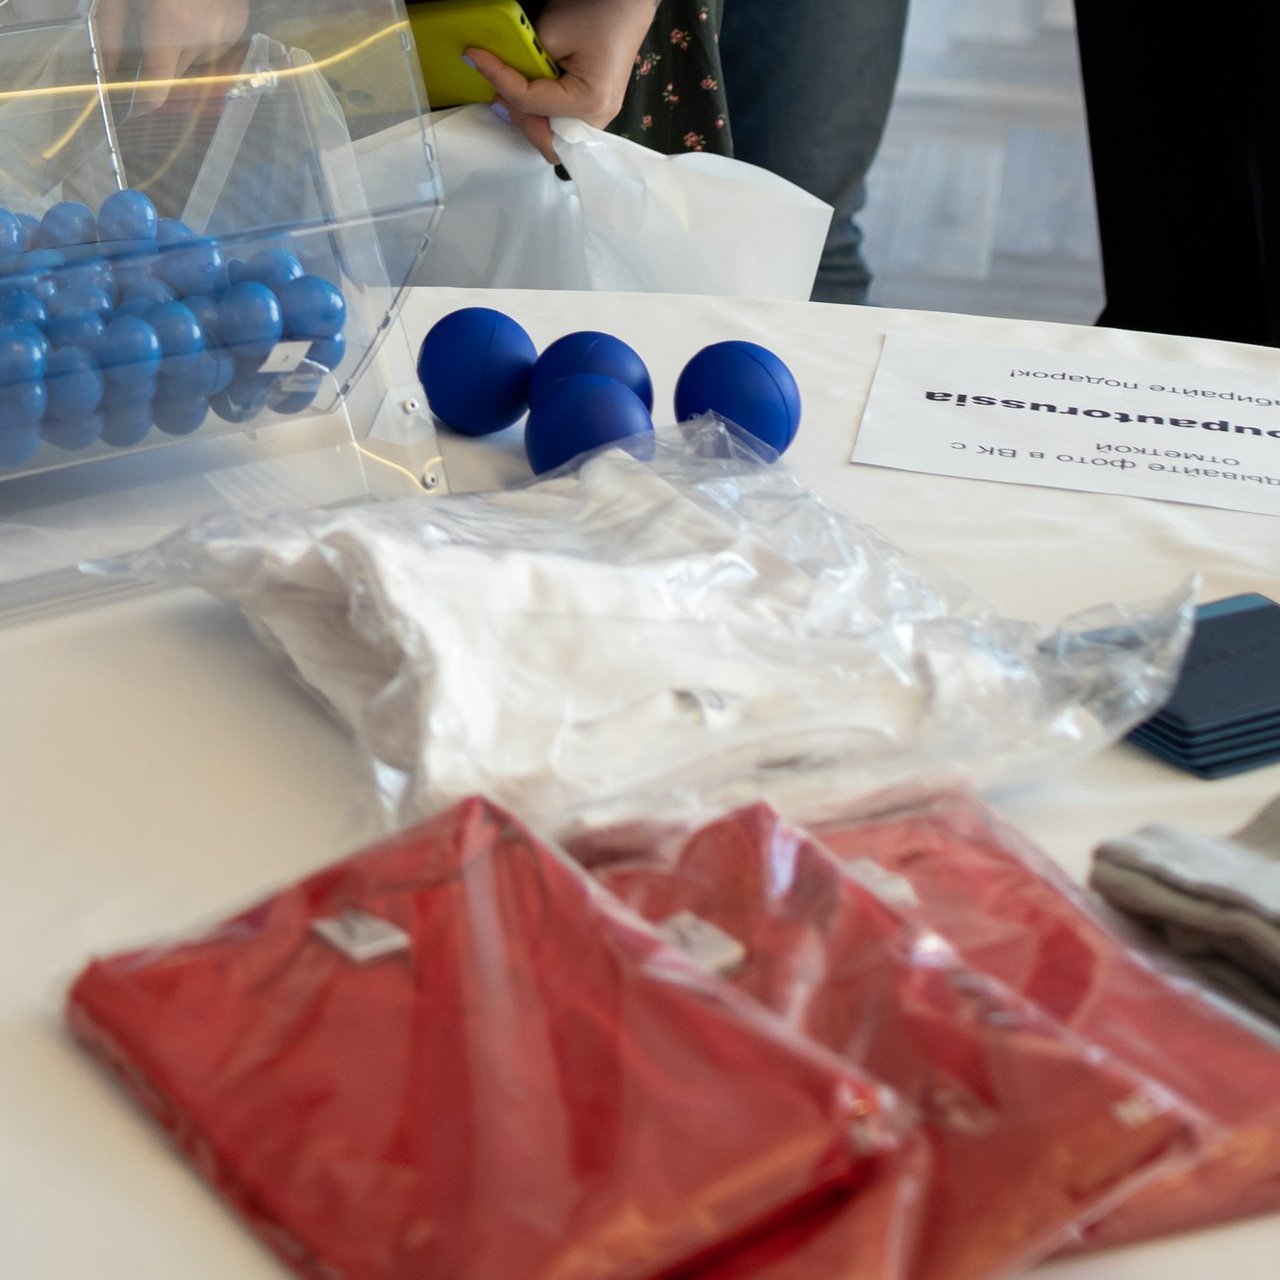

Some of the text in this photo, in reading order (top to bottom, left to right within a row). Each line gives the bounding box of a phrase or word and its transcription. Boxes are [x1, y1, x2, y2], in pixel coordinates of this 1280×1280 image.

[1010, 369, 1280, 408] бирайте подарок!
[950, 441, 967, 451] с
[976, 444, 1017, 459] ВК
[1028, 450, 1045, 460] в
[1056, 453, 1136, 472] фото
[1095, 442, 1241, 468] отметкой
